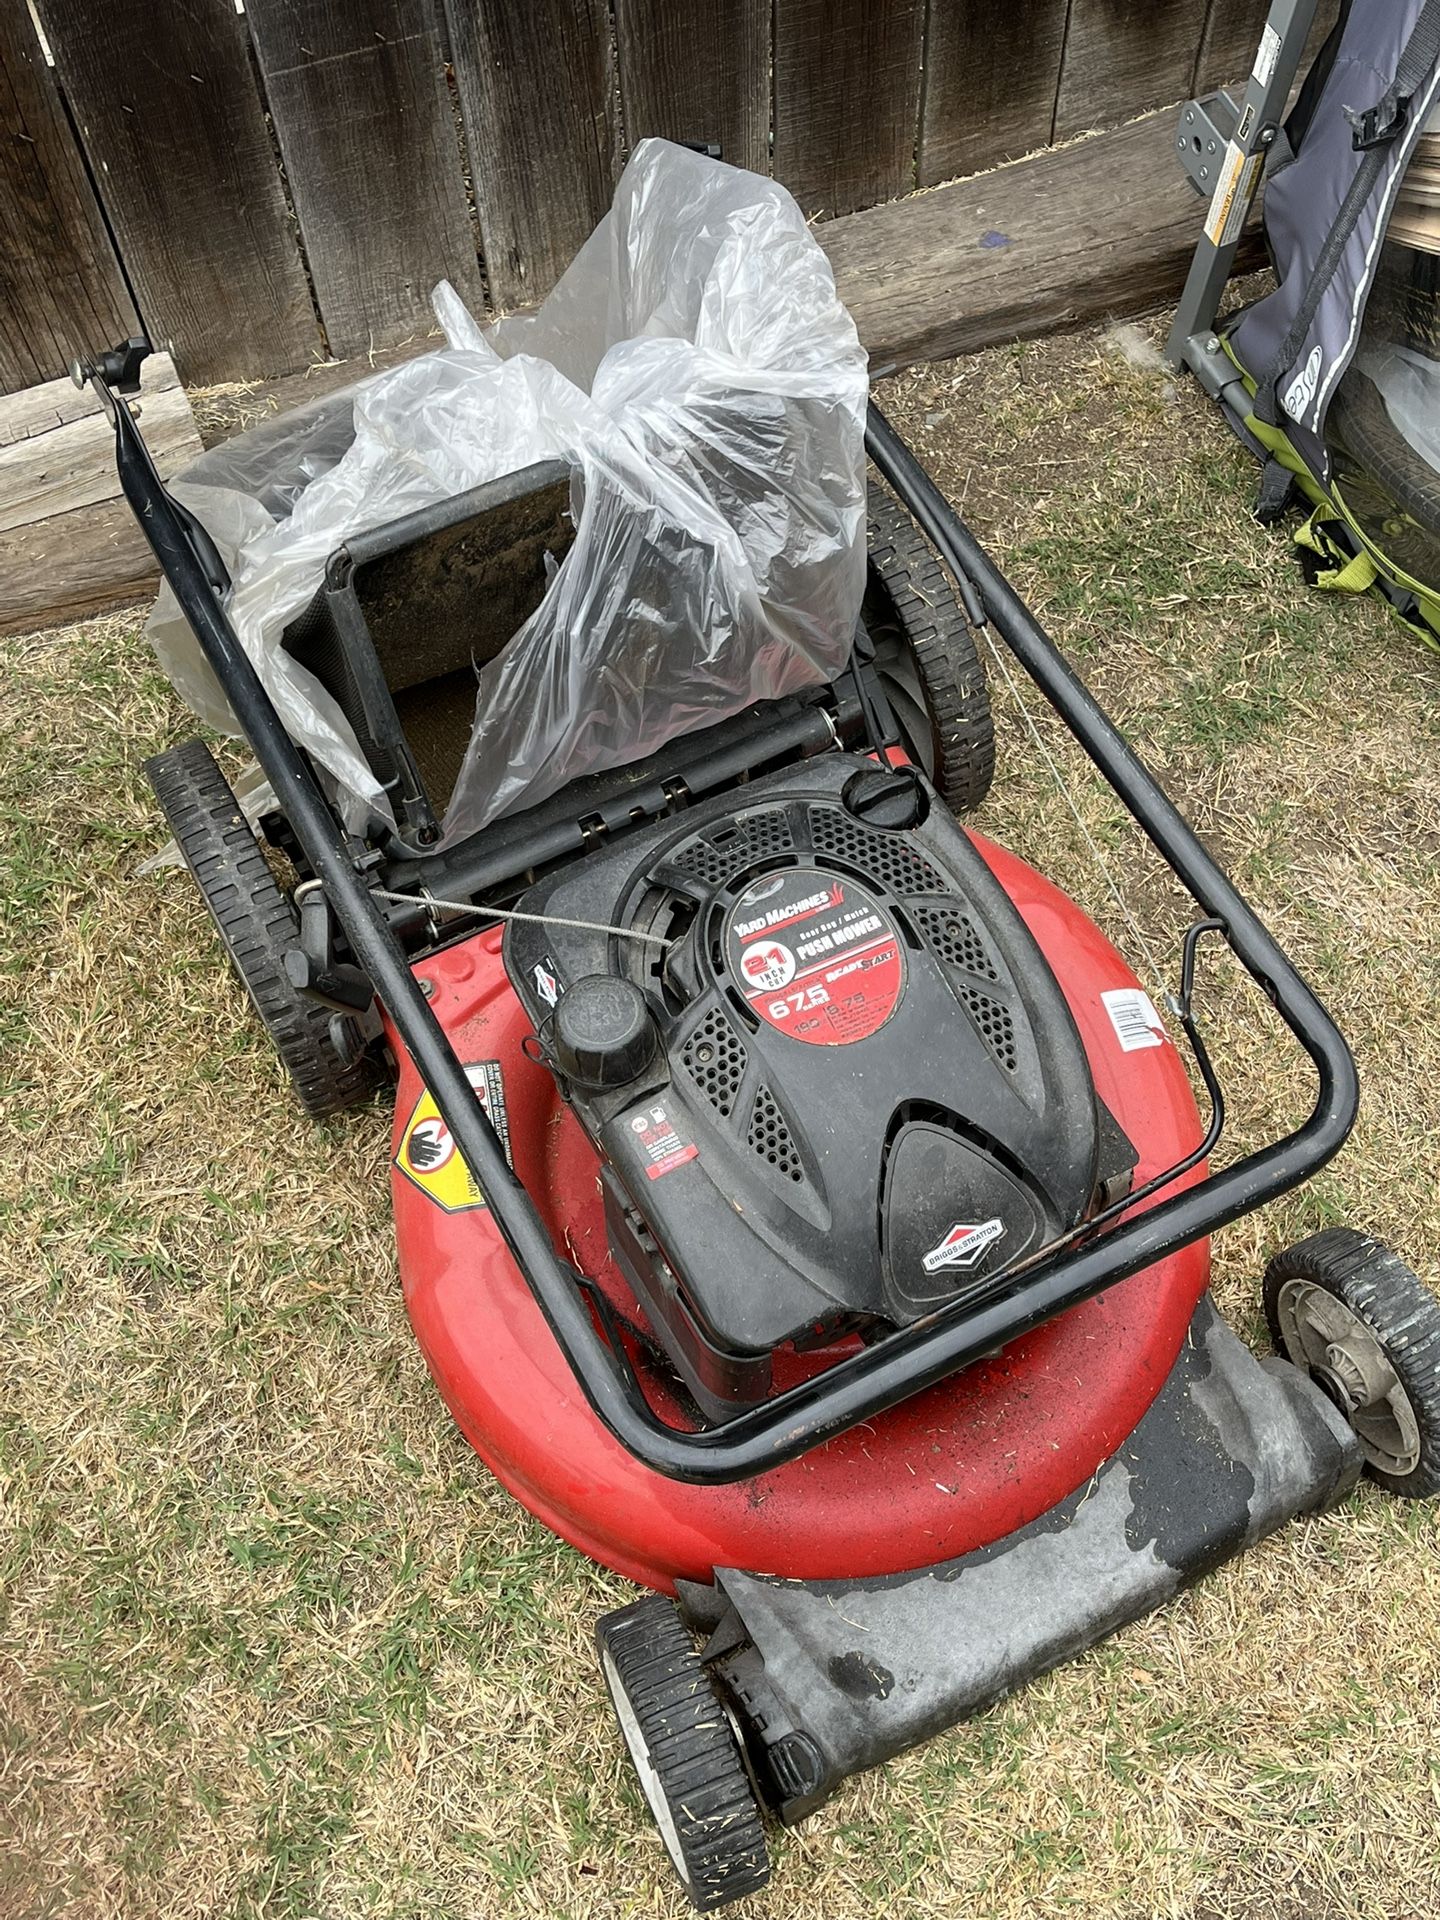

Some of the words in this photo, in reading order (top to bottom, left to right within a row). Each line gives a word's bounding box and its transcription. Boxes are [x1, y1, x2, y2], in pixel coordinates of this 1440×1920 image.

[734, 916, 767, 937] YARD
[767, 891, 829, 925] MACHINES
[796, 937, 833, 960] PUSH
[835, 915, 882, 944] MOWER
[744, 947, 786, 976] 21
[760, 967, 785, 982] INCH
[768, 976, 784, 987] CUT
[768, 984, 828, 1019] 675
